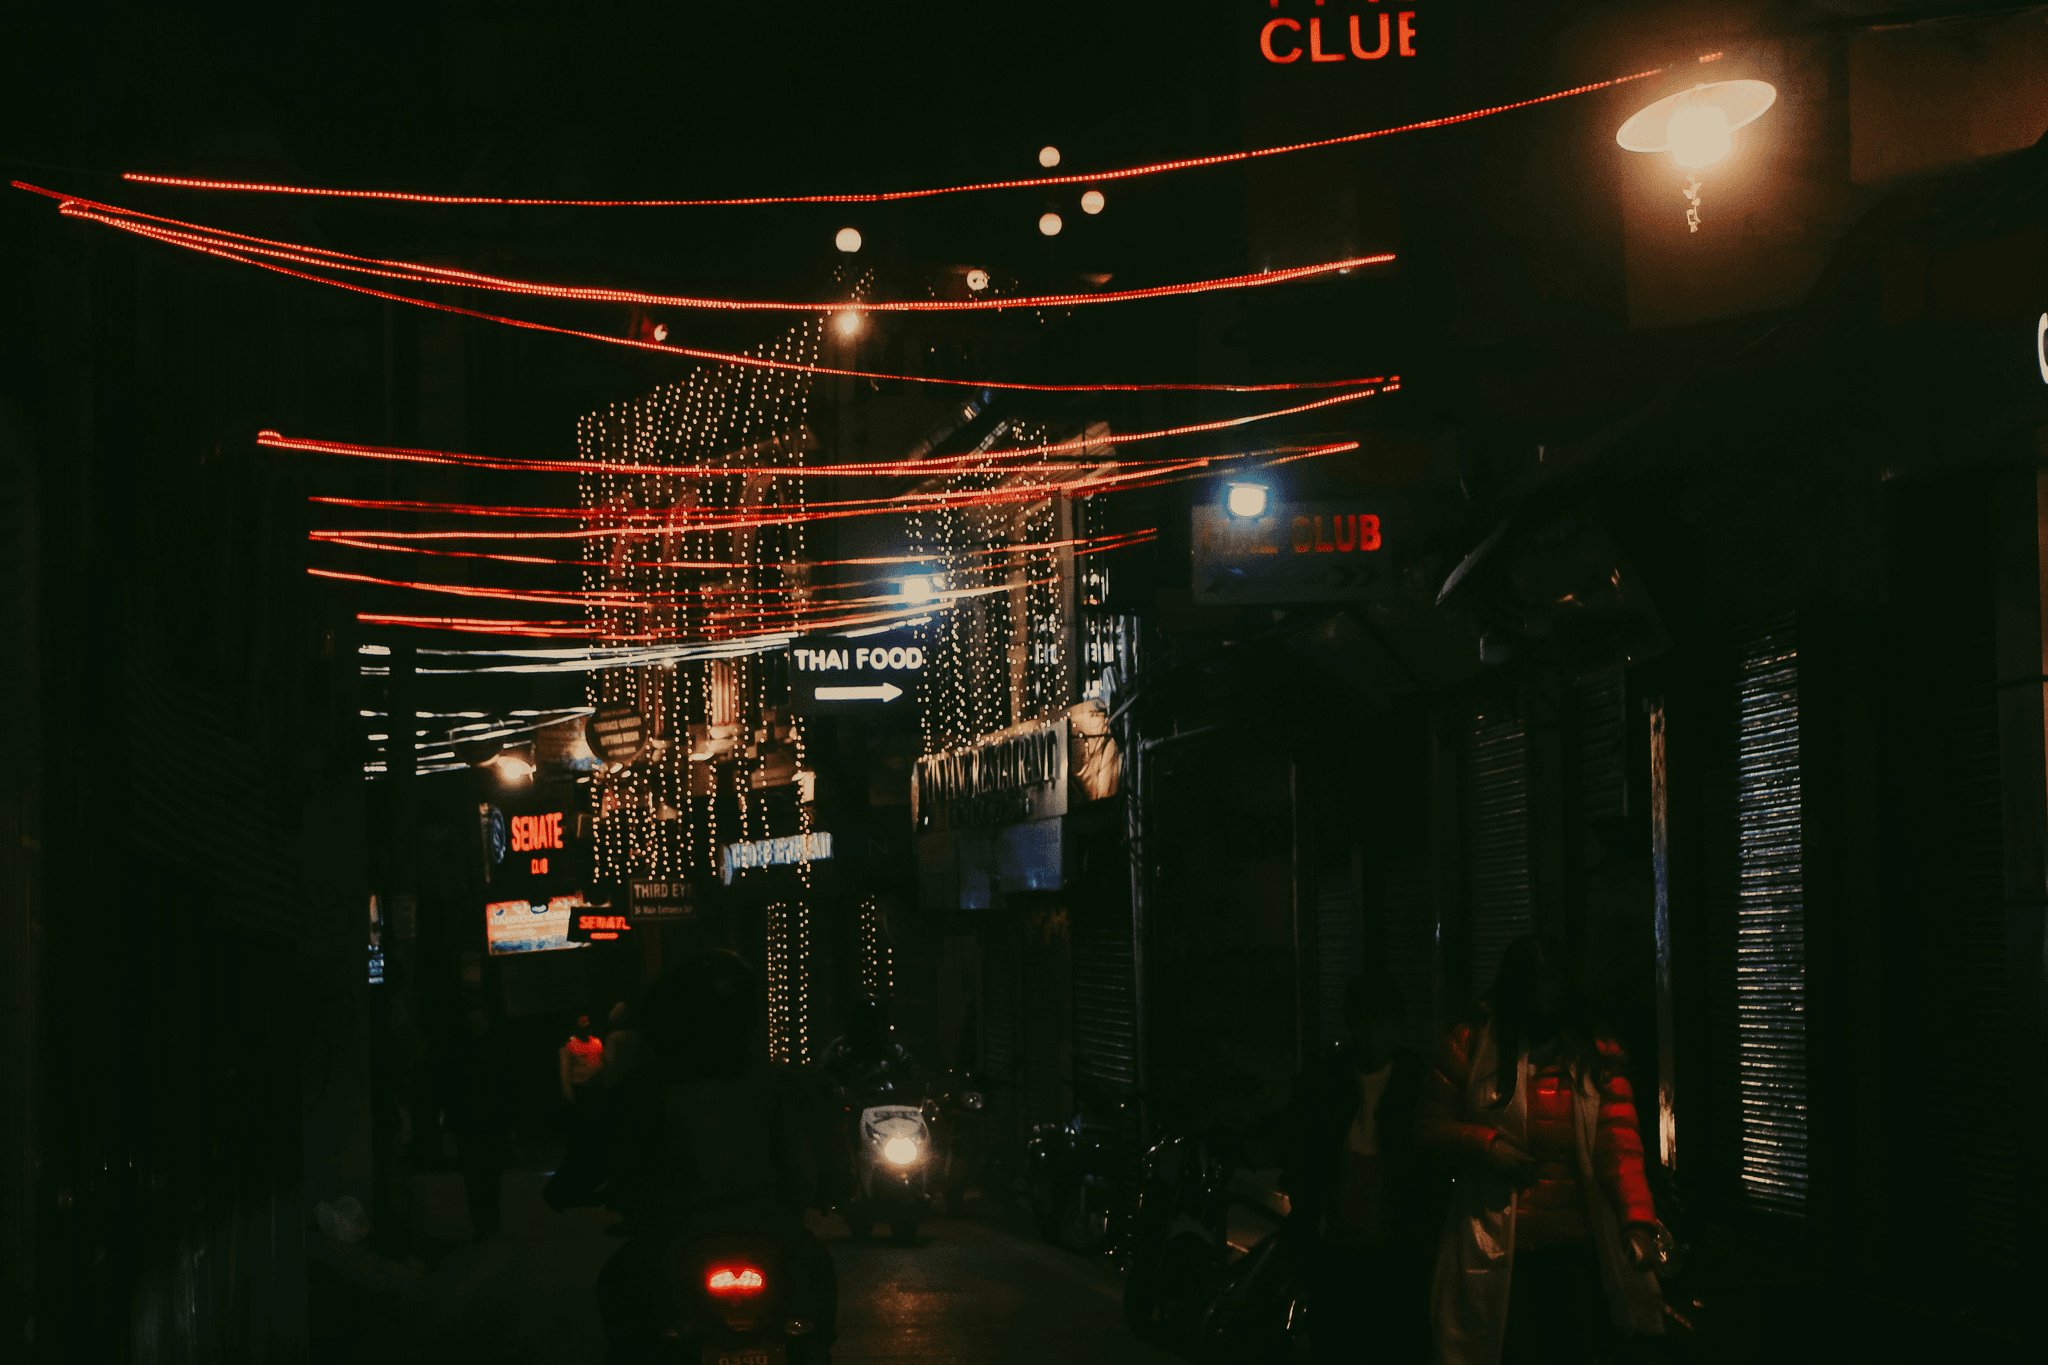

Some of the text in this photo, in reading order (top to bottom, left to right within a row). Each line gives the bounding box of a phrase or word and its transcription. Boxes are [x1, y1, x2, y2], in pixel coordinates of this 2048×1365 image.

[1292, 514, 1382, 553] CLUB
[793, 646, 923, 671] THAI FOOD
[511, 812, 563, 852] SENATE
[633, 883, 693, 898] THIRD EYE
